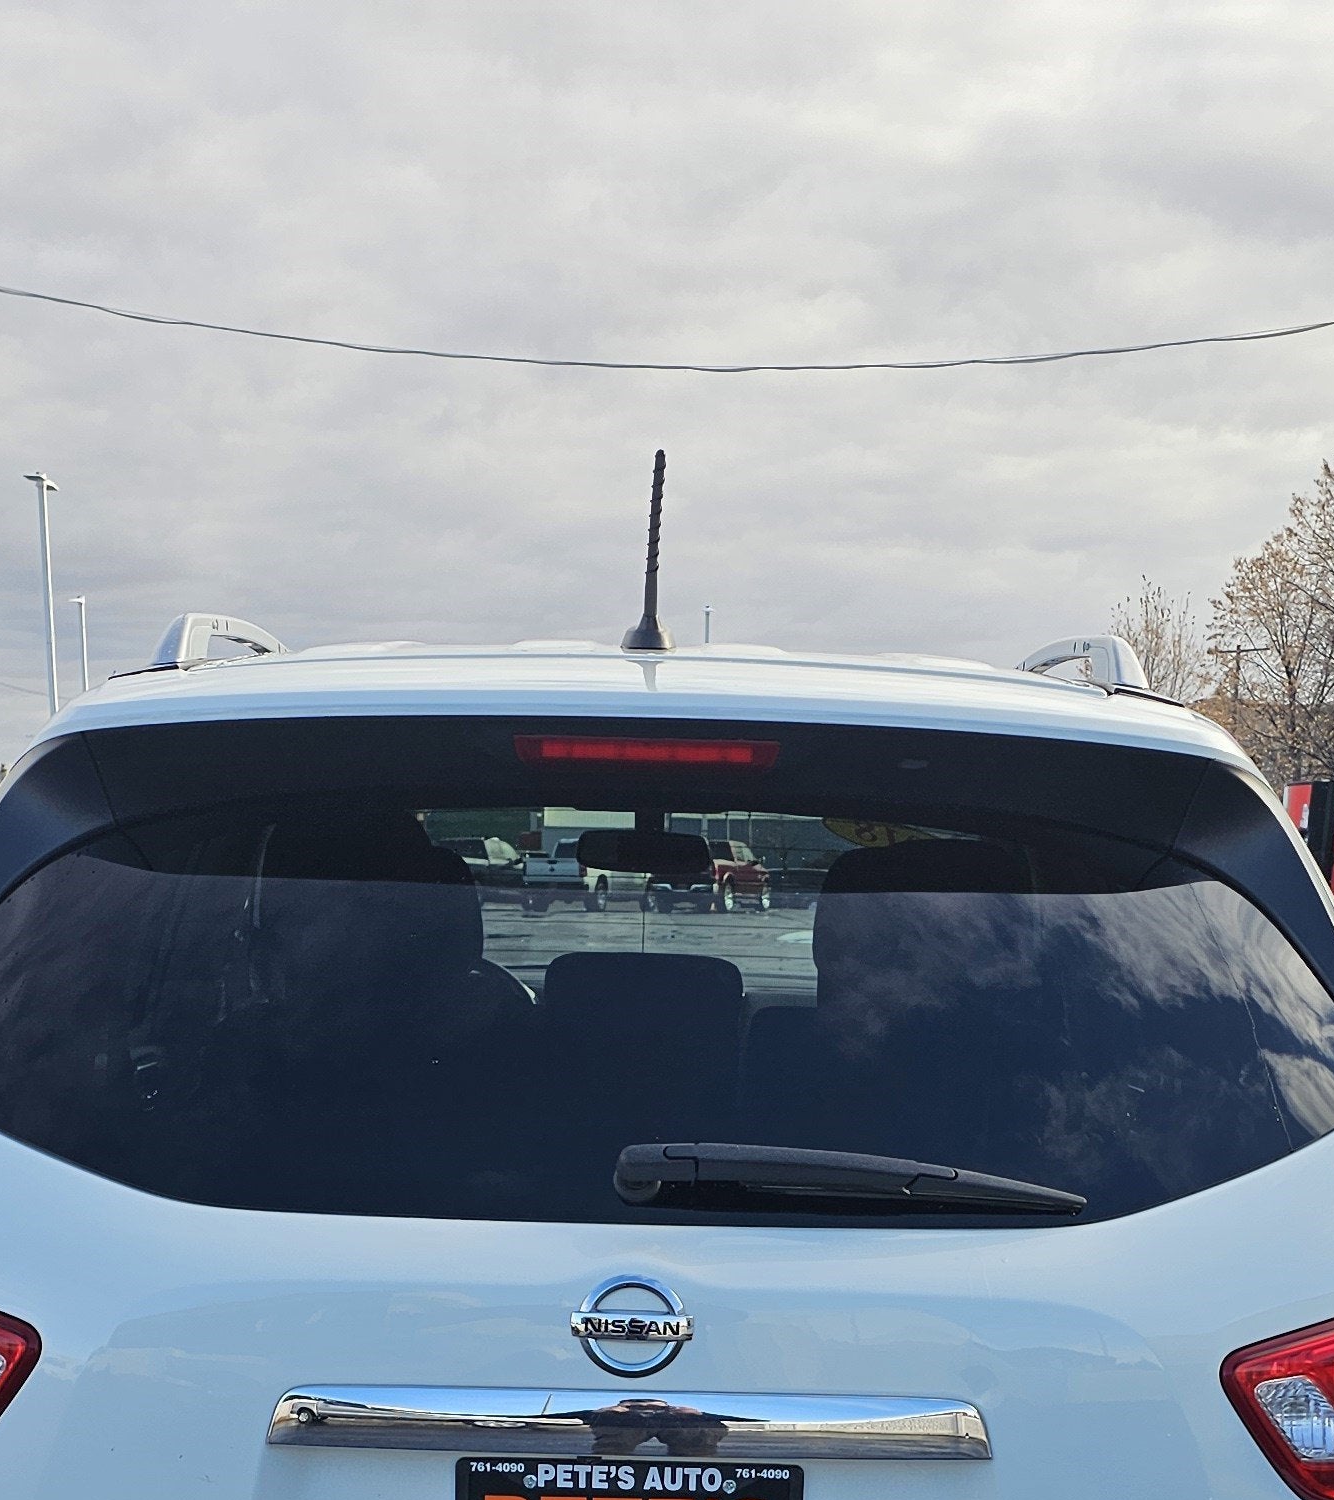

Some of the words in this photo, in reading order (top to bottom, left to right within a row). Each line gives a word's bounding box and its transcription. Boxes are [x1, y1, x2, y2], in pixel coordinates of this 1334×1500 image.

[581, 1316, 680, 1336] NISSAN
[470, 1461, 525, 1473] 761-4090
[735, 1468, 790, 1480] 761-4090
[537, 1463, 635, 1490] PETE'S
[643, 1466, 722, 1491] AUTO
